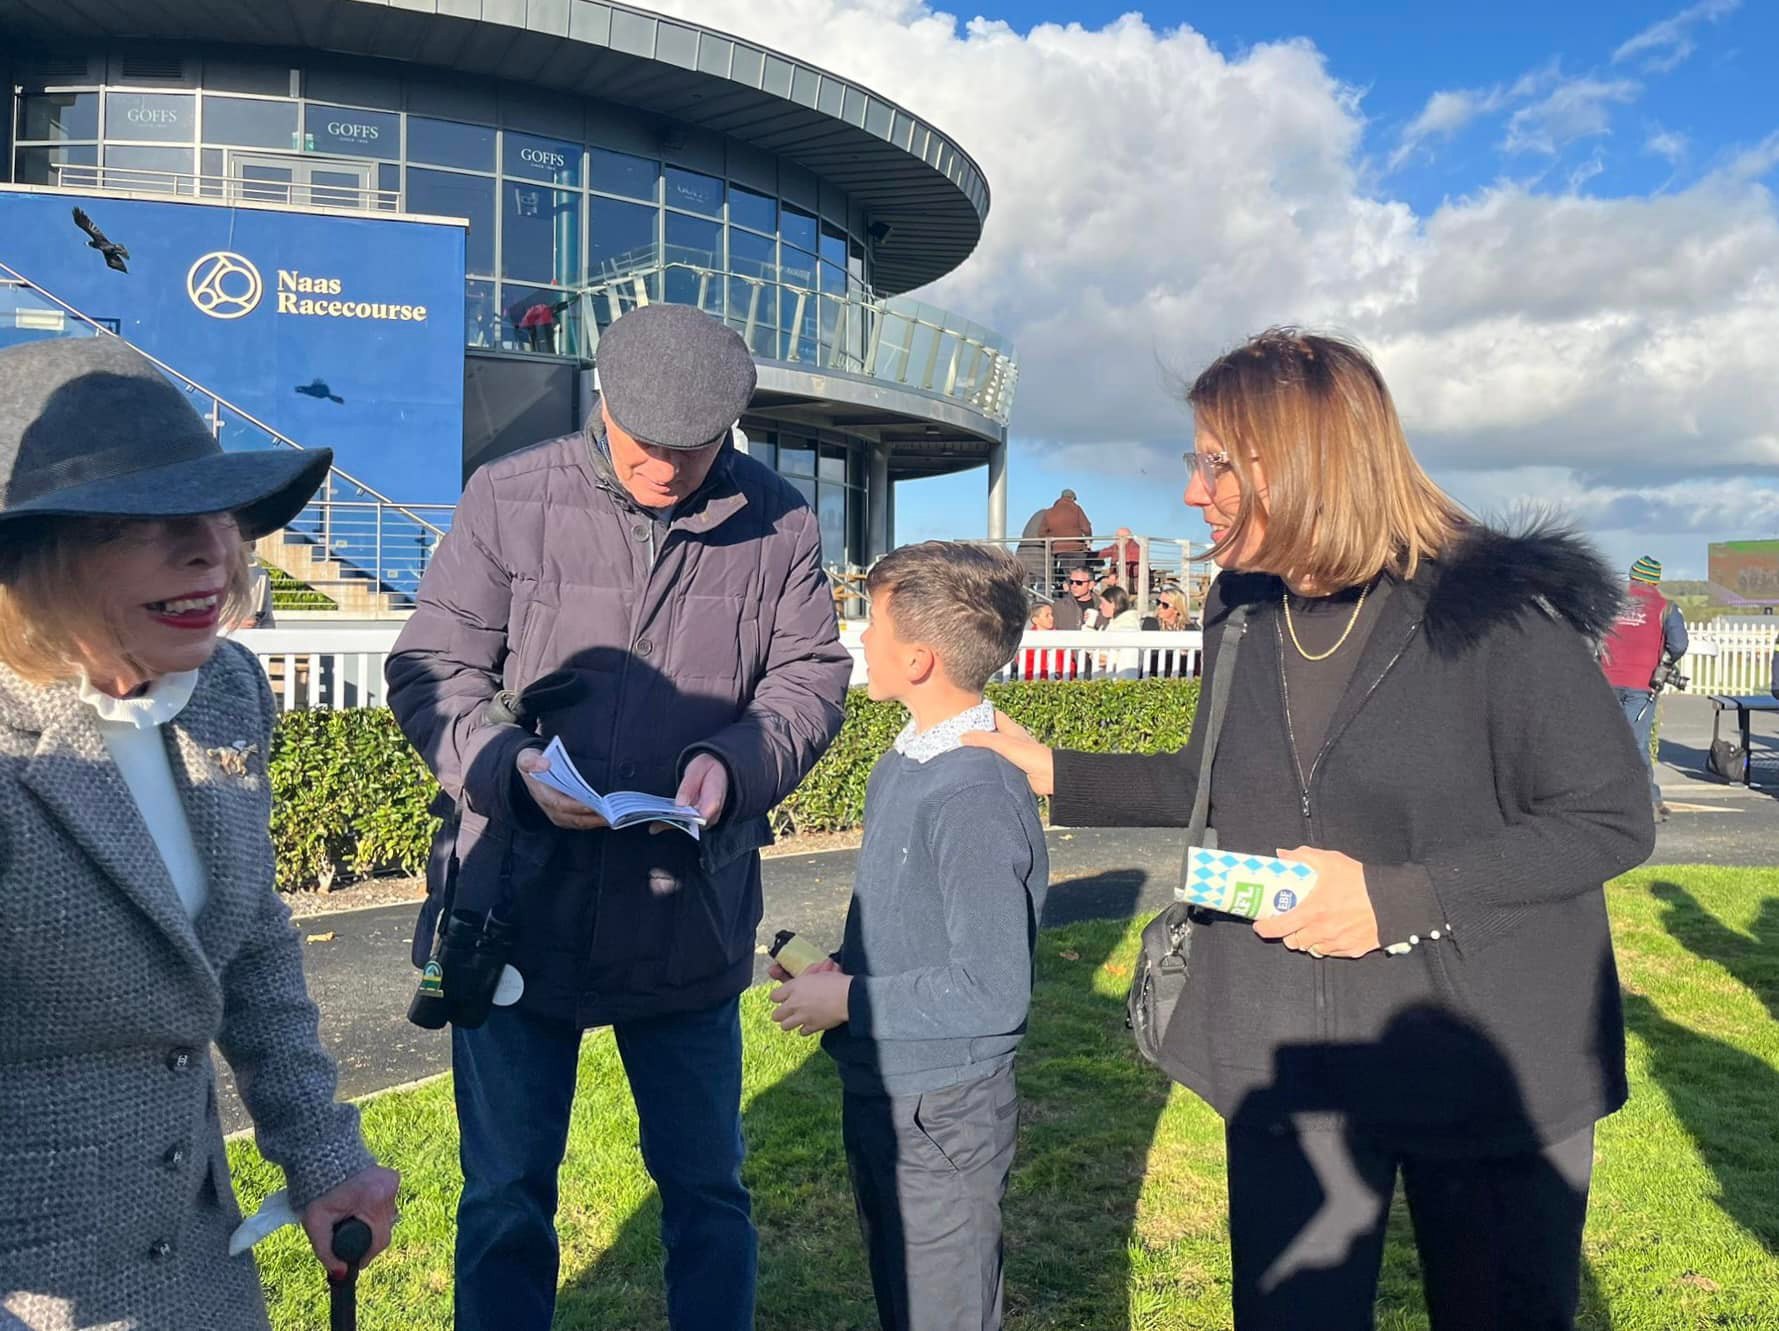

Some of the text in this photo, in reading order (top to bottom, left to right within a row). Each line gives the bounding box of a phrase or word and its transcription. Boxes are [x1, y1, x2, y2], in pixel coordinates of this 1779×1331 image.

[127, 109, 177, 122] GOFFS
[327, 121, 379, 139] GOFFS
[520, 147, 565, 167] GOFFS
[276, 269, 342, 295] Naas
[276, 291, 427, 321] Racecourse
